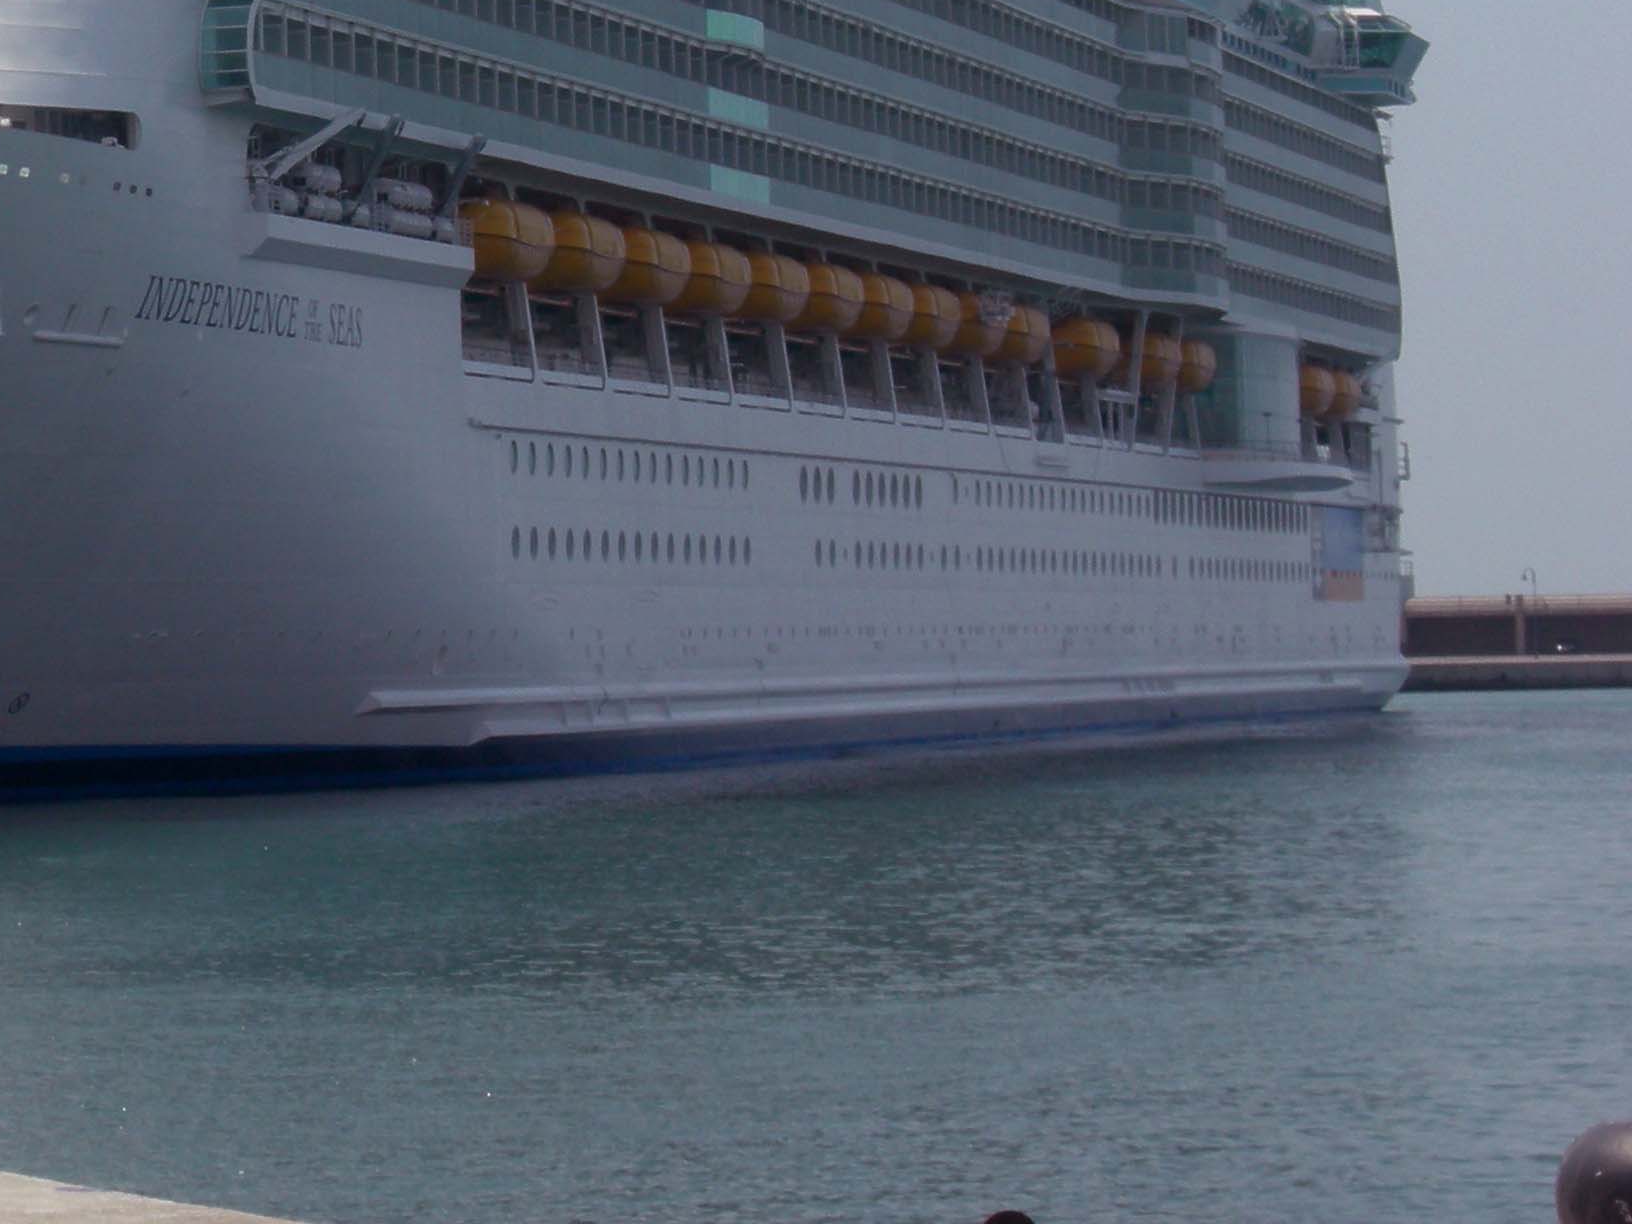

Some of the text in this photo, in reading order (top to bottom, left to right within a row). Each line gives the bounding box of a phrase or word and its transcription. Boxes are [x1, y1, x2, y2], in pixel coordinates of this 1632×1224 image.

[134, 274, 300, 338] INDEPENDENCE
[303, 321, 323, 343] THE
[328, 303, 363, 349] SEAS
